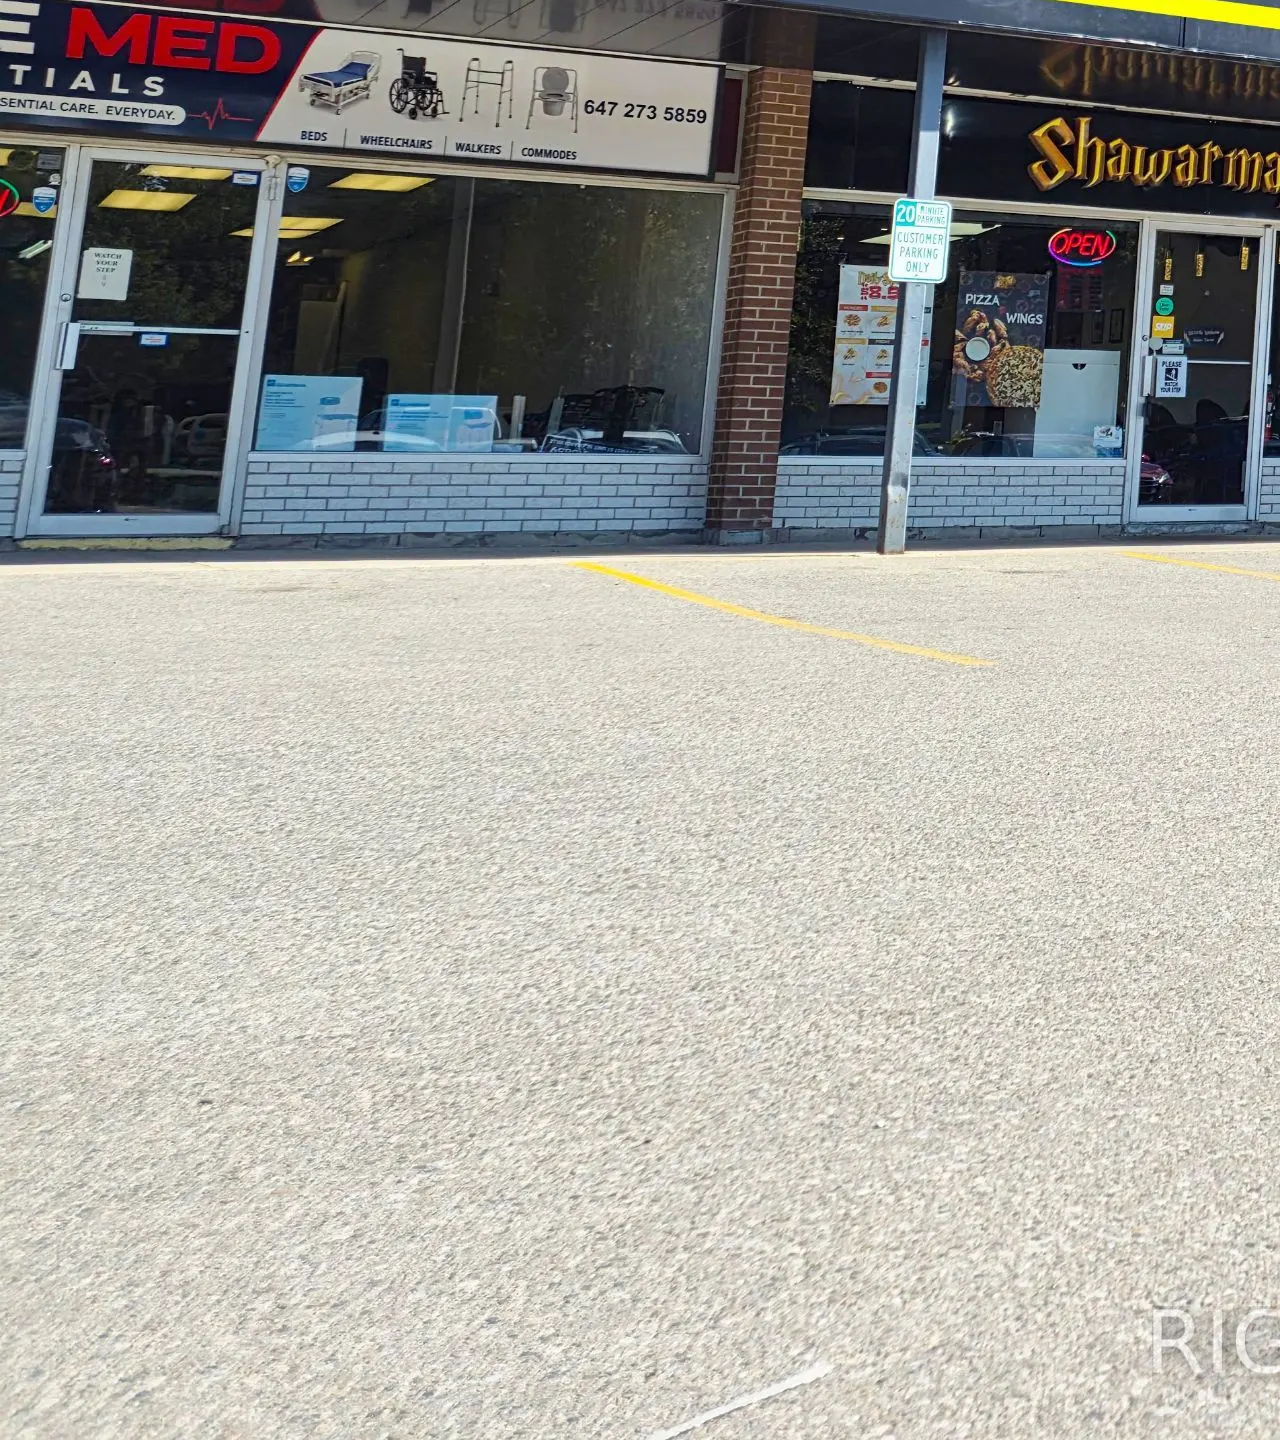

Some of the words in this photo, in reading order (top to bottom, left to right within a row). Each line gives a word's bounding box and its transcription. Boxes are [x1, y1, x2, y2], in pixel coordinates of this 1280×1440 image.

[66, 7, 282, 74] MED
[9, 64, 165, 97] TIALS
[0, 97, 56, 111] SENTIAL
[60, 101, 98, 114] CARE.
[106, 105, 175, 120] EVERYDAY.
[584, 99, 618, 117] 647
[624, 102, 657, 121] 273
[663, 106, 708, 125] 5859
[300, 130, 328, 142] BEDS
[360, 134, 433, 150] WHEELCHAIRS
[455, 142, 502, 155] WALKERS
[521, 147, 577, 160] COMMODES
[897, 205, 916, 223] 20
[920, 206, 944, 215] MINUTE
[917, 215, 945, 224] PARKING
[898, 232, 944, 245] CUSTOMER
[1052, 232, 1111, 256] OPEN
[900, 246, 939, 259] PARKING
[906, 261, 930, 272] ONLY
[965, 293, 1000, 306] PIZZA
[1006, 312, 1043, 325] WINGS
